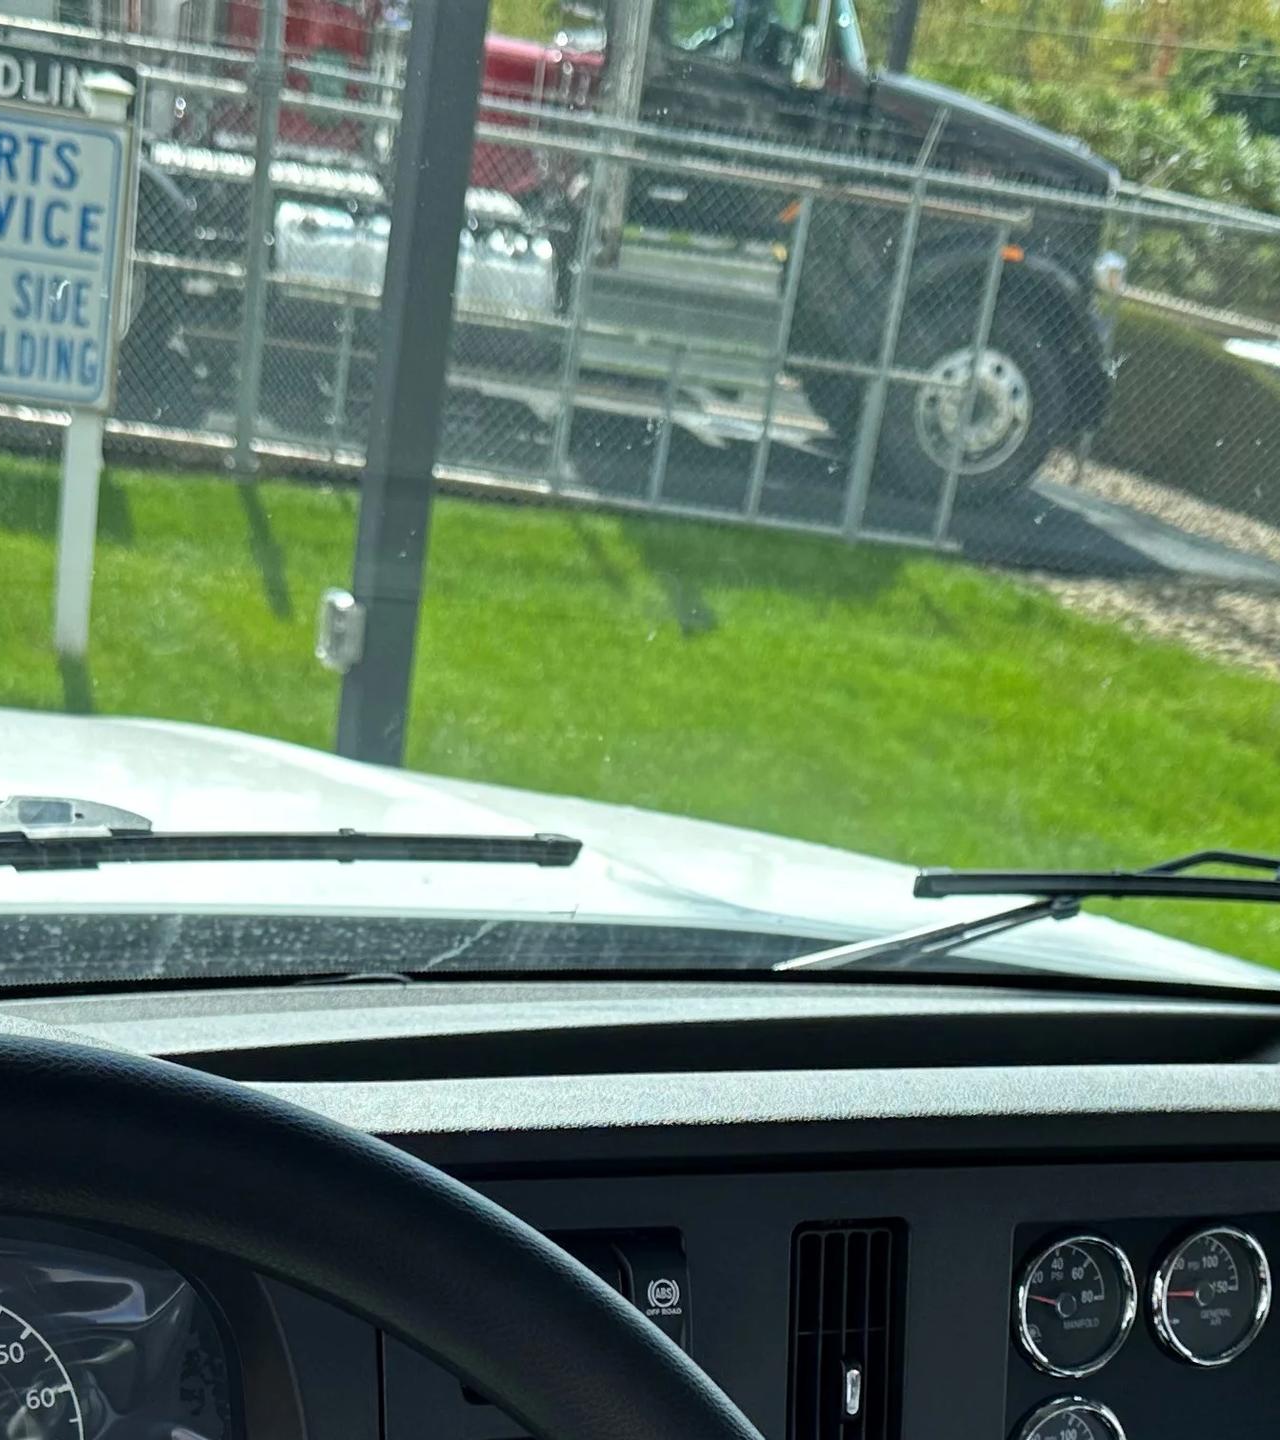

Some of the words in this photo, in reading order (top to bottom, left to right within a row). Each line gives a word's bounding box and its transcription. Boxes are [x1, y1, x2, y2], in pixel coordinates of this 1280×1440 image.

[11, 270, 92, 329] SIDE
[1051, 1257, 1064, 1269] 40
[1202, 1255, 1219, 1268] 100
[1051, 1271, 1064, 1280] PSI
[1071, 1267, 1084, 1280] 60
[655, 1287, 673, 1299] ABS
[1081, 1290, 1093, 1303] 80
[25, 1387, 56, 1410] 60
